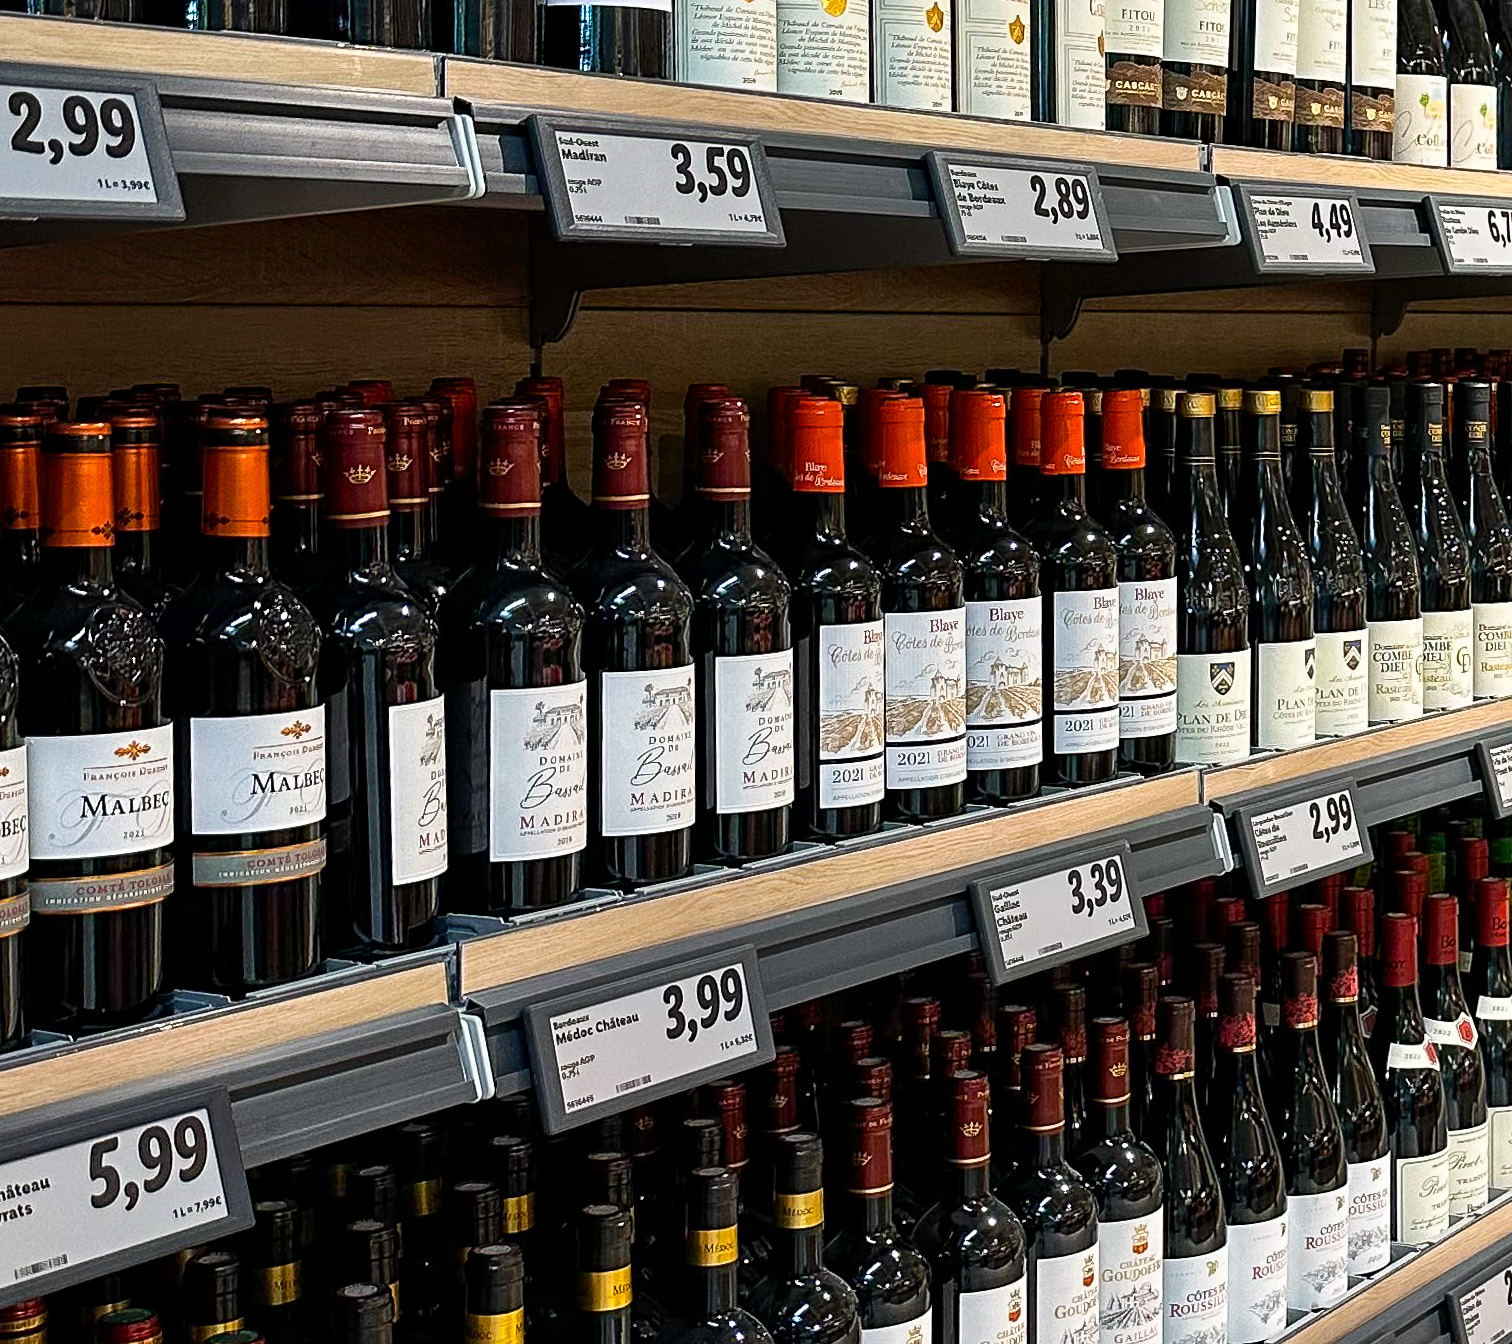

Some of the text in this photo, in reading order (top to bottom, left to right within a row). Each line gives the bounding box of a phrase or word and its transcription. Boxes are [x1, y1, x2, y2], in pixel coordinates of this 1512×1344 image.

[1121, 8, 1155, 21] FITOU
[8, 91, 135, 165] 2,99
[562, 149, 607, 162] Madiran
[97, 179, 102, 188] 1
[105, 179, 111, 188] L
[671, 144, 750, 203] 3,59
[1030, 175, 1089, 225] 2,89
[1312, 203, 1353, 243] 4,49
[1065, 719, 1093, 732] 2021
[898, 752, 930, 766] 2021
[250, 767, 325, 795] MALBEC
[832, 768, 864, 783] 2021
[79, 790, 170, 818] MALBEC
[1309, 794, 1352, 843] 2,99
[77, 875, 126, 896] COMTÉ
[1068, 859, 1122, 917] 3,39
[663, 968, 743, 1042] 3,99
[555, 1012, 639, 1045] Médoc Château
[90, 1115, 207, 1211] 5,99
